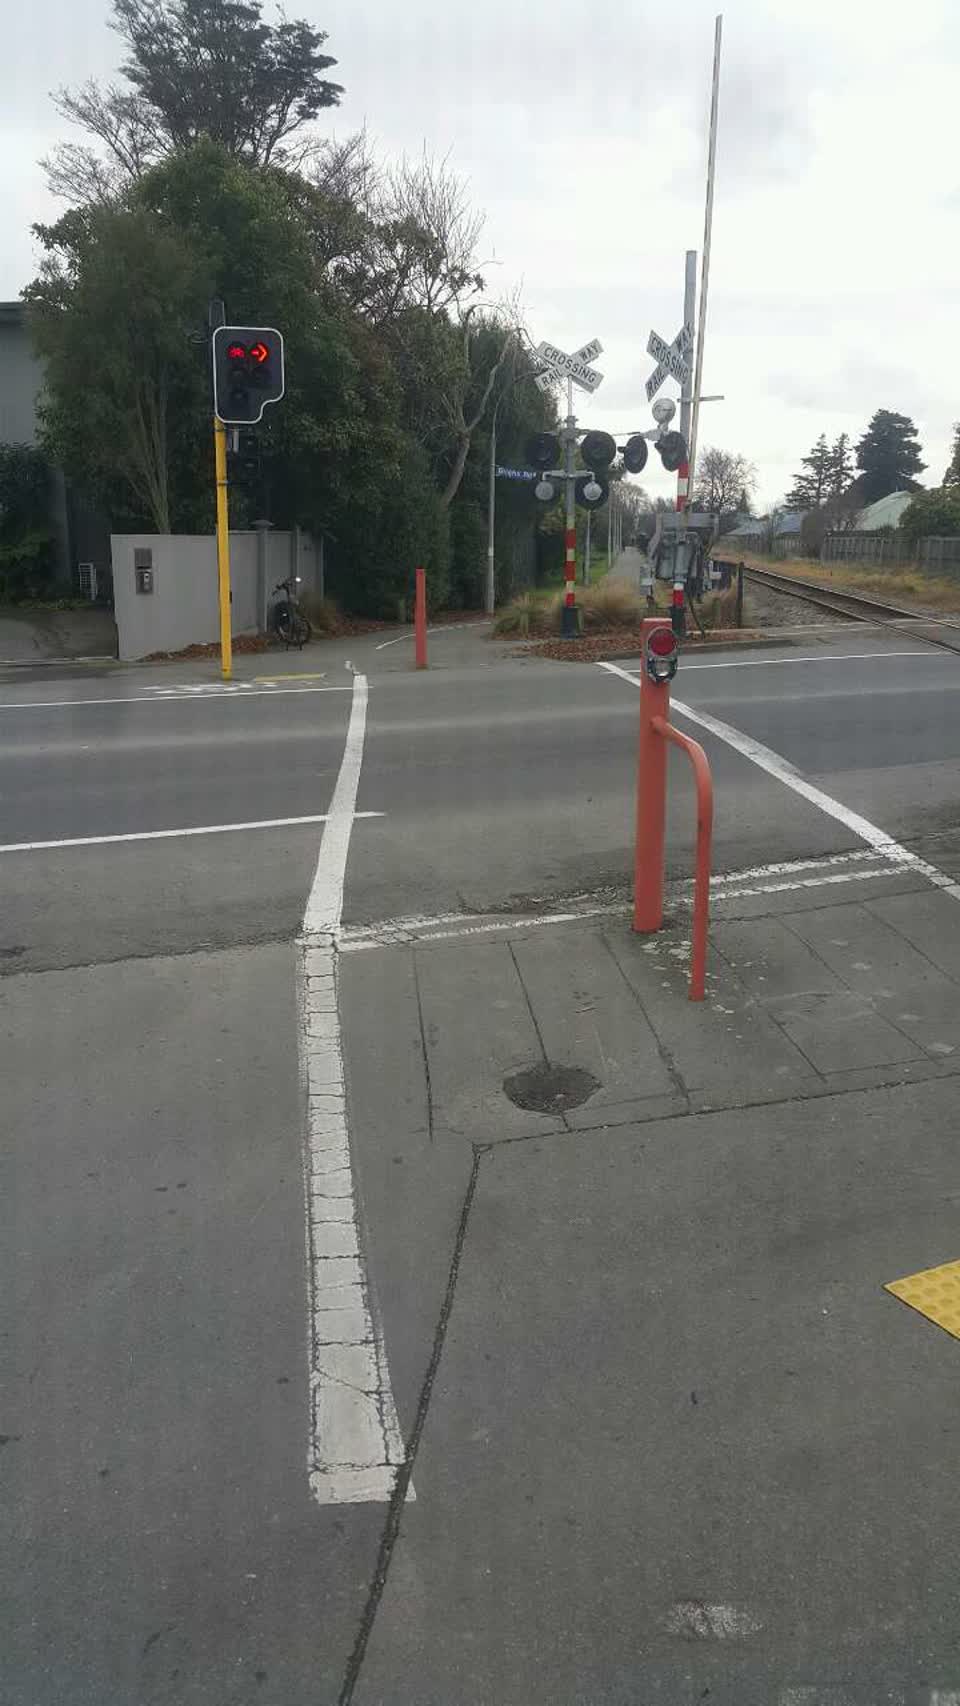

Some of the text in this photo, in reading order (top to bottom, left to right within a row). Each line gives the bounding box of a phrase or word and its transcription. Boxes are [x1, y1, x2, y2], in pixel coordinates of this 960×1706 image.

[541, 344, 599, 387] RAIL WAY
[544, 347, 597, 384] CROSSING
[646, 322, 692, 396] RAIL WAY
[651, 337, 689, 384] CROSSING
